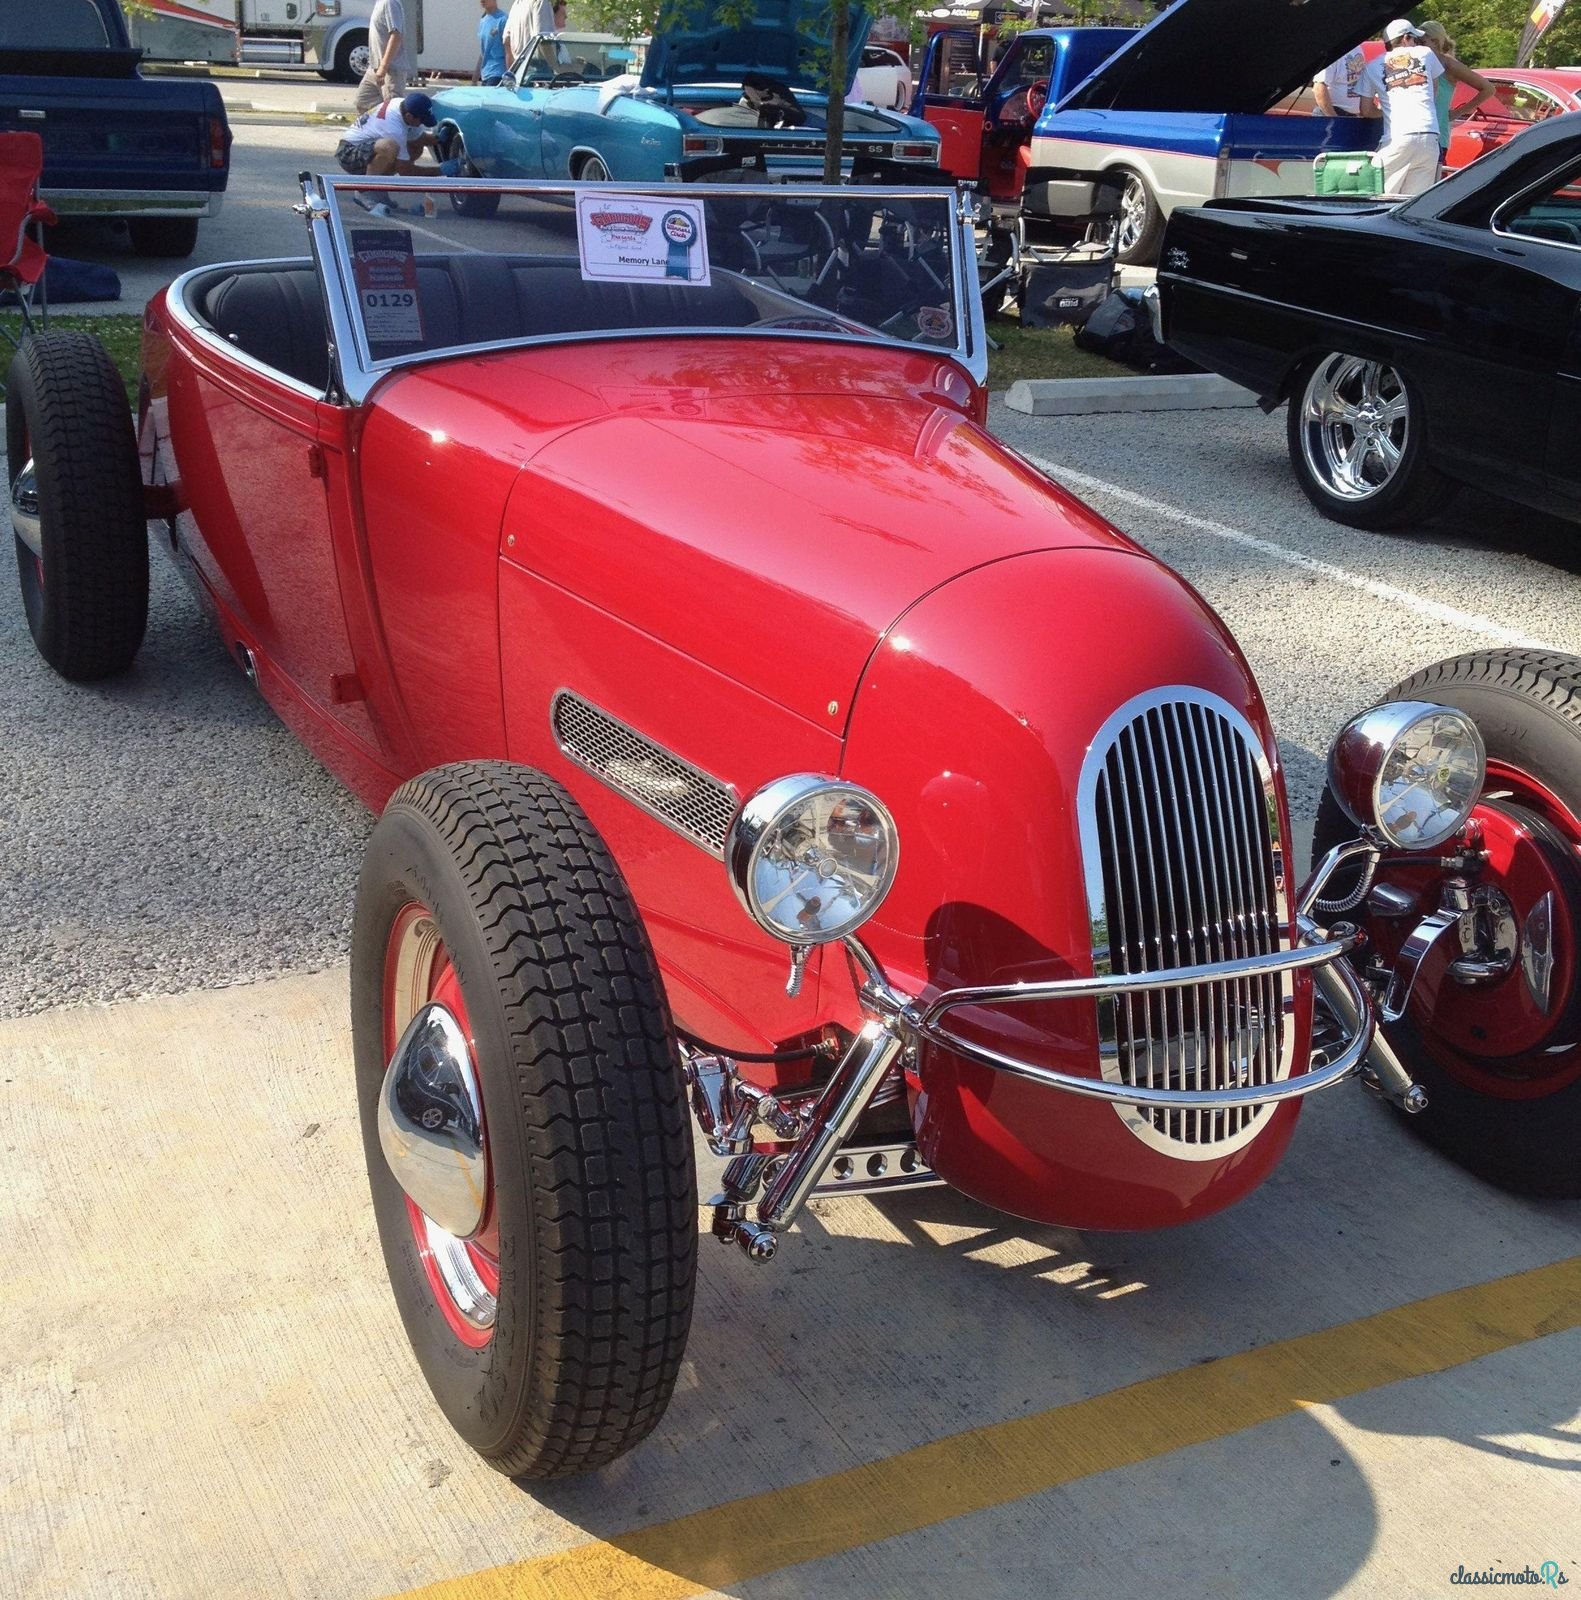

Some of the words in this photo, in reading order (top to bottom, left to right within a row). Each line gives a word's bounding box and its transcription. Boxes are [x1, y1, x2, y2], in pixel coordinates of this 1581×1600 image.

[868, 145, 883, 153] SS
[618, 255, 649, 266] Memory
[366, 294, 414, 307] 0129
